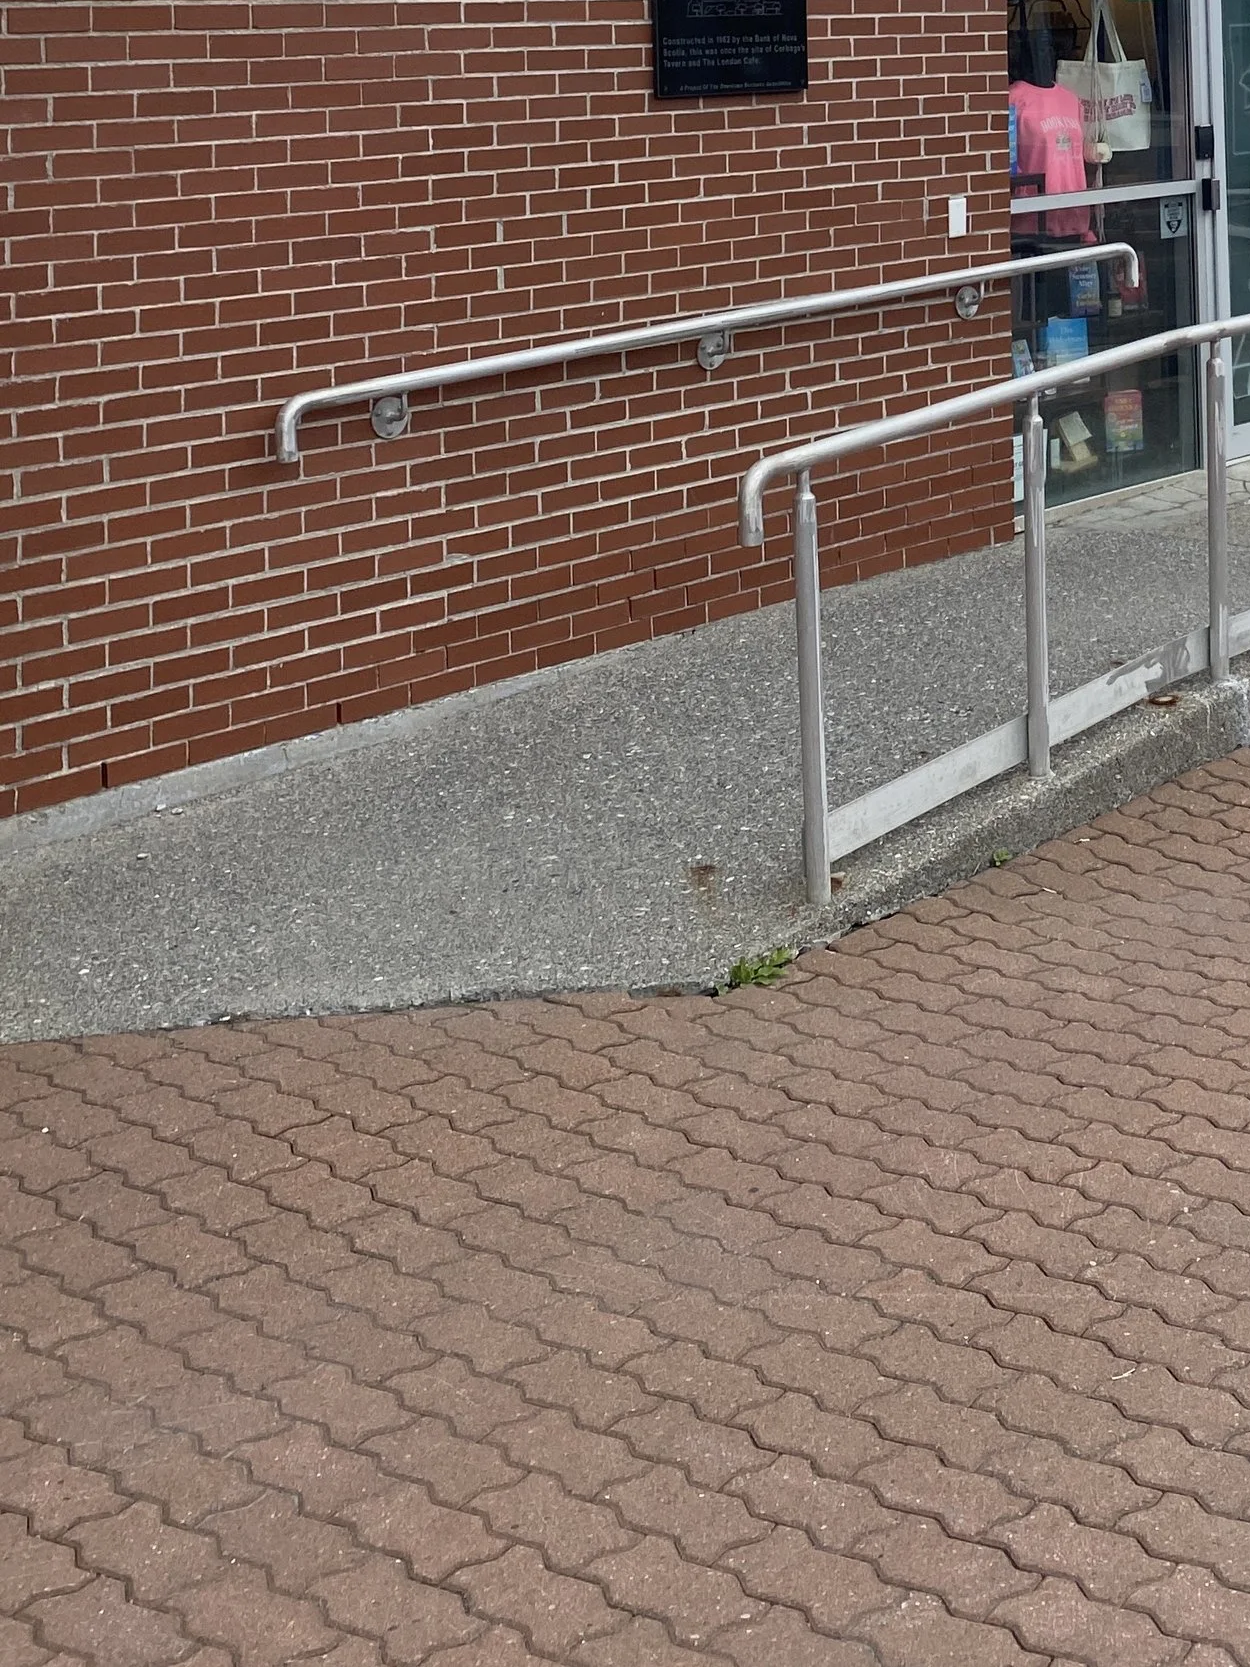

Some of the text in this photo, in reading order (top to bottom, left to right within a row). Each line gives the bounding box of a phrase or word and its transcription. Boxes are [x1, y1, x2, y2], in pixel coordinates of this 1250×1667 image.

[662, 36, 706, 46] Constructed
[731, 35, 741, 45] by
[742, 35, 753, 43] the
[754, 33, 771, 43] Bank
[773, 33, 780, 42] of
[781, 33, 798, 42] Nova
[689, 47, 703, 56] this
[720, 47, 736, 55] once
[738, 45, 749, 54] the
[751, 45, 764, 54] site
[765, 44, 772, 53] of
[663, 59, 687, 68] Tavern
[688, 59, 701, 67] and
[702, 57, 715, 67] The
[716, 56, 742, 66] London
